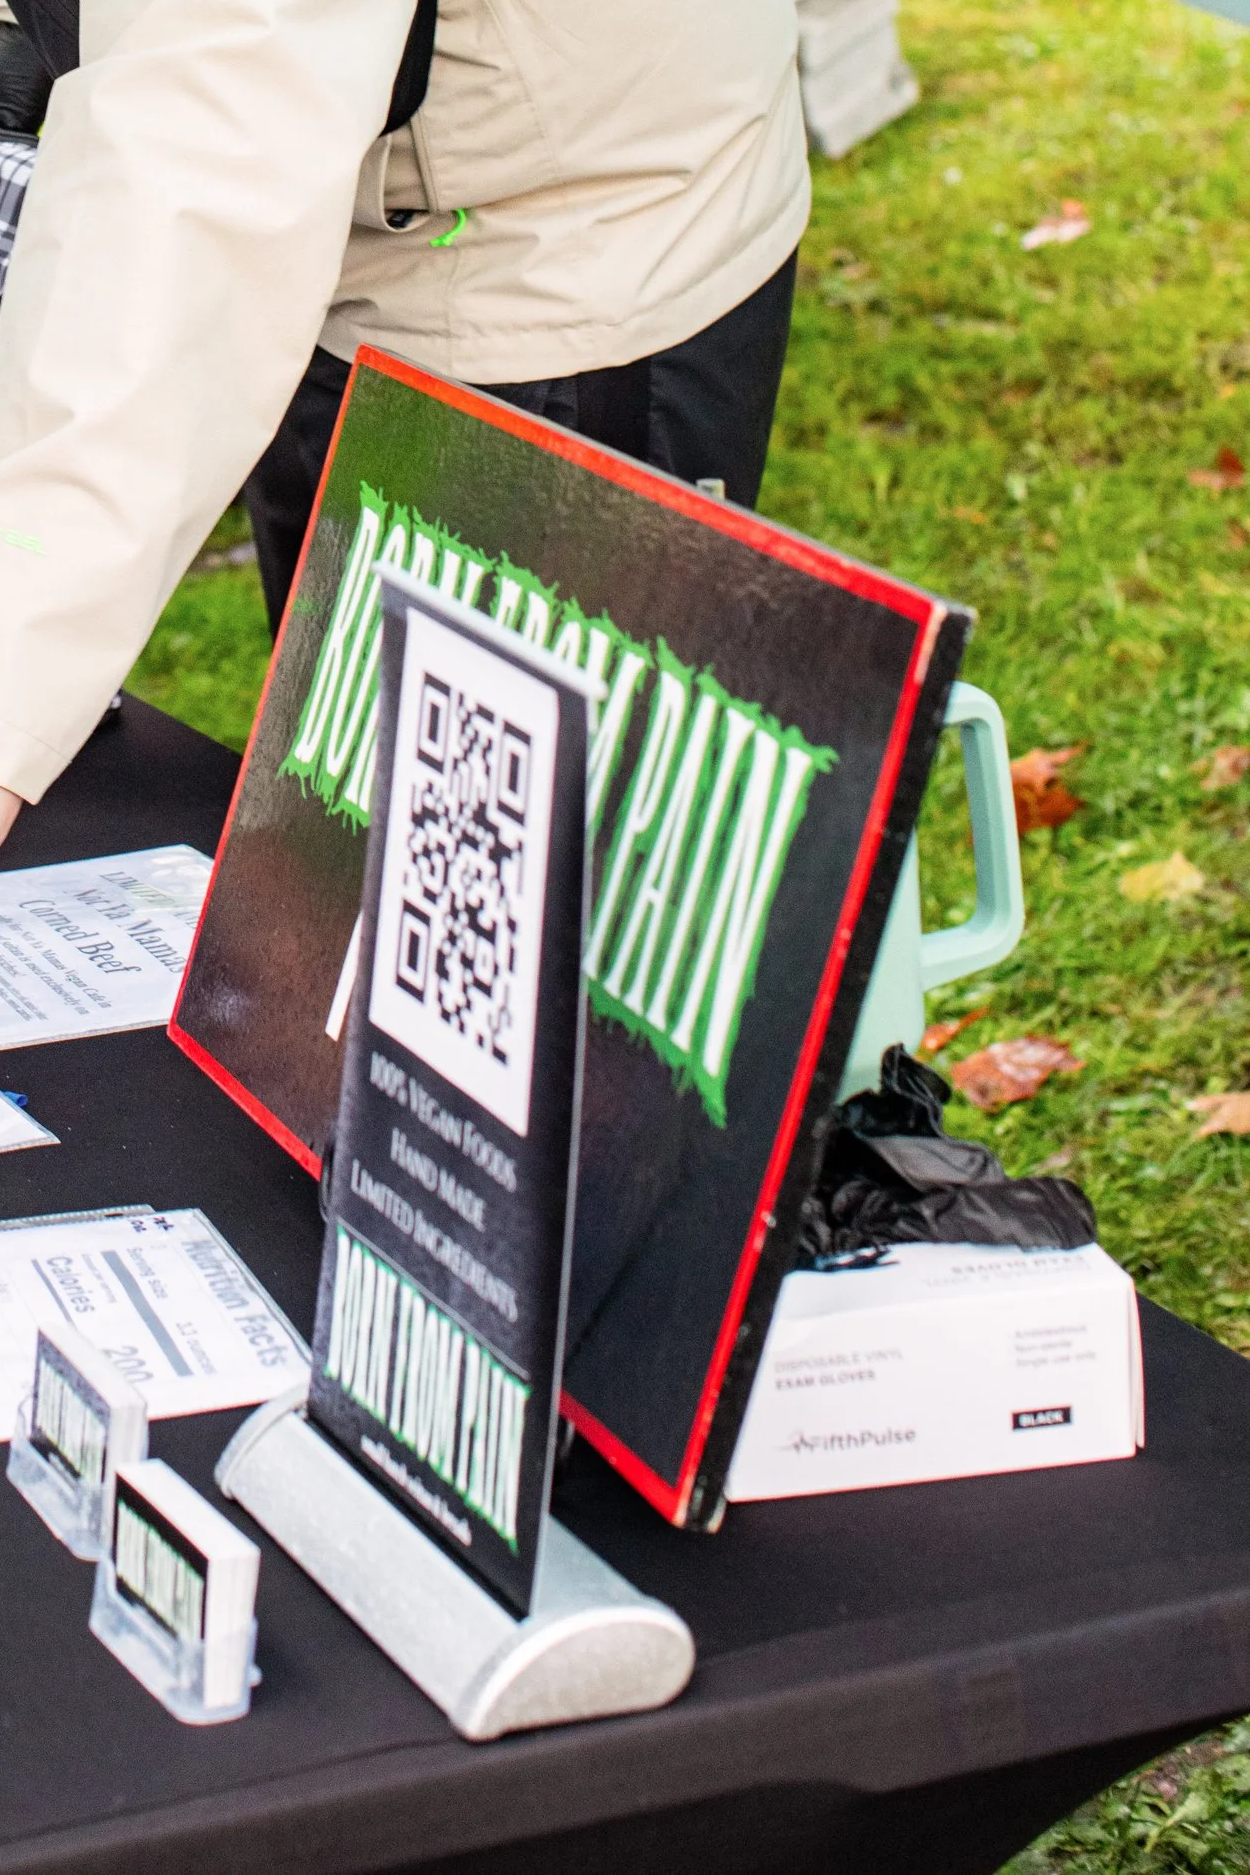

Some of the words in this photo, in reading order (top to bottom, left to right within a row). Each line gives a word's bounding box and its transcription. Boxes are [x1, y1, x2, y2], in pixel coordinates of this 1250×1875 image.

[63, 887, 114, 906] Not
[584, 659, 822, 1090] PAIN
[15, 898, 102, 941] Corned
[74, 940, 143, 976] Beef
[92, 903, 140, 920] Ya
[113, 918, 192, 974] Mamas
[56, 969, 93, 988] Vegan
[368, 1047, 408, 1108] 100%
[406, 1076, 463, 1152] VEGAN
[460, 1117, 518, 1197] FOODS
[389, 1124, 439, 1195] HAND
[437, 1164, 487, 1235] MADE
[349, 1155, 414, 1239] LIMITED
[412, 1207, 519, 1328] INGREDIENTS
[120, 1246, 161, 1278] Serving
[143, 1278, 174, 1299] size
[40, 1255, 105, 1314] Calories
[99, 1344, 158, 1384] 200
[228, 1313, 298, 1368] Facts
[1019, 1411, 1064, 1426] BLACK
